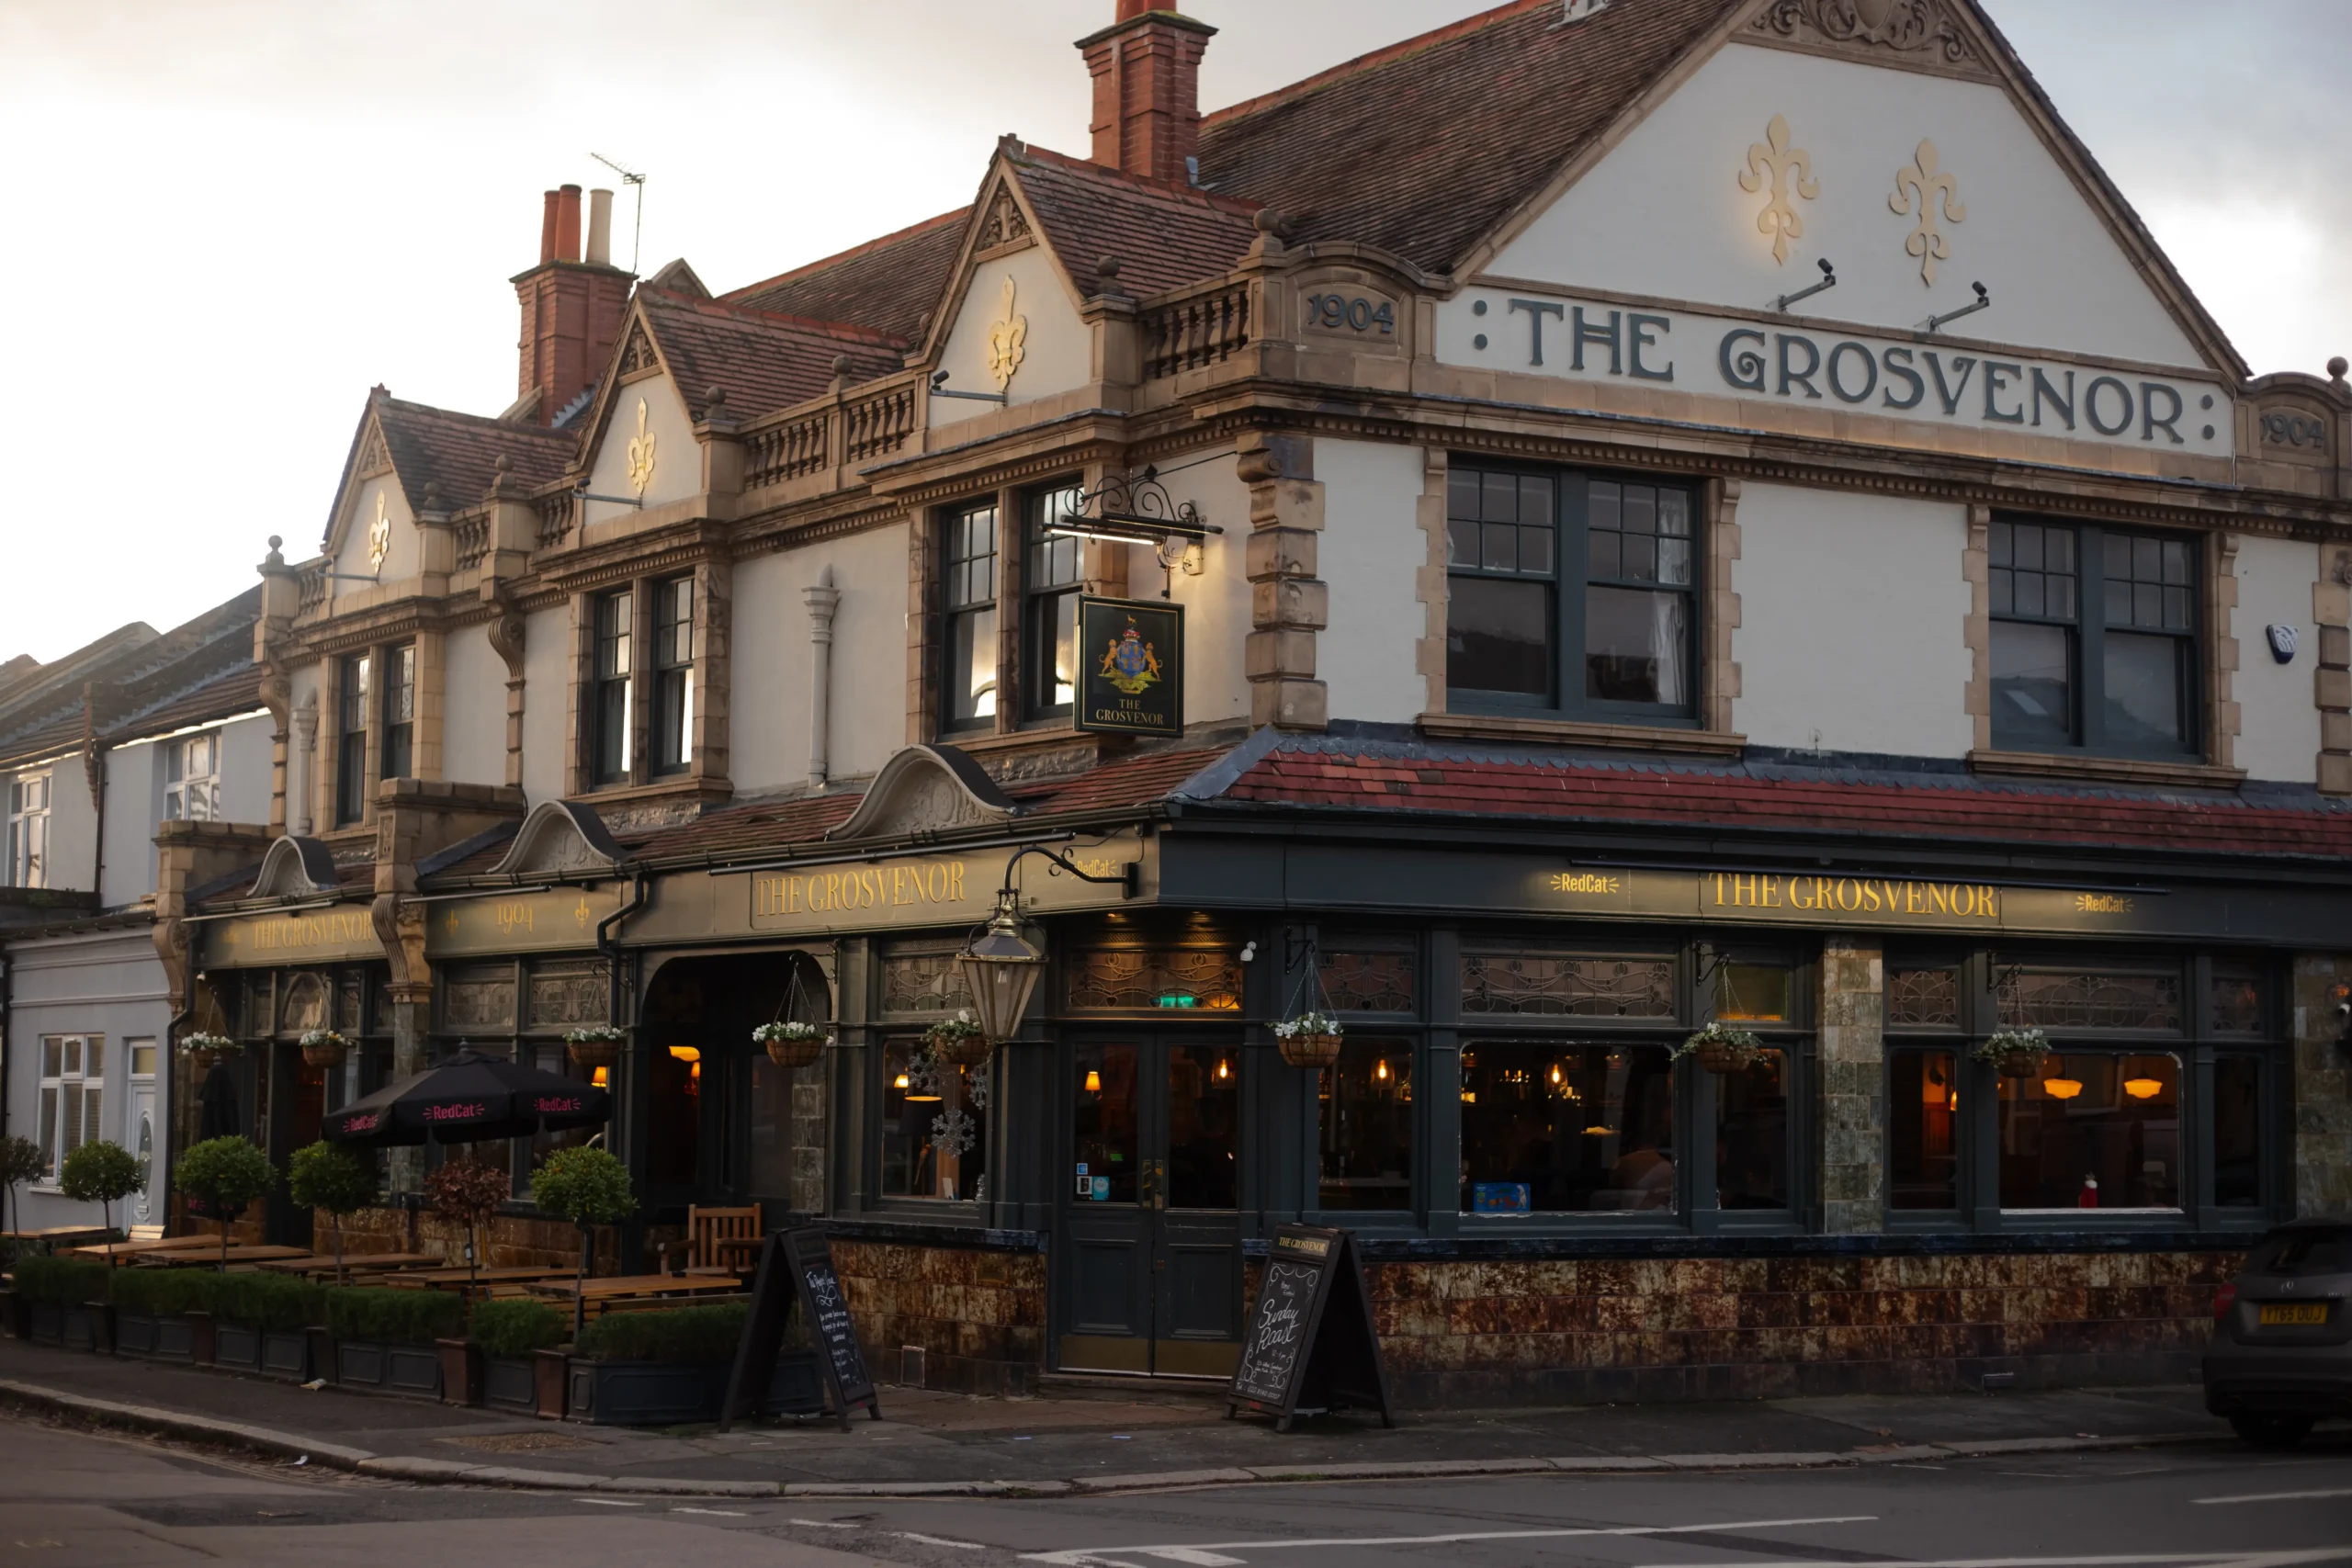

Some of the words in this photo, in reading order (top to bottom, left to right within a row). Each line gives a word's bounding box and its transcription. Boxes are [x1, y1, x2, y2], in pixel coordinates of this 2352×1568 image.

[1308, 294, 1394, 333] 1904
[1509, 297, 1675, 382] THE
[1717, 327, 2185, 445] GROSVENOR
[1119, 698, 1140, 710] THE
[1095, 709, 1163, 725] GROSVENOR
[757, 875, 803, 916] THE
[807, 862, 966, 911] GROSVENOR
[1562, 873, 1608, 893] RedCat
[1708, 873, 1781, 908] THE
[1789, 875, 1996, 917] GROSVENOR
[2086, 894, 2124, 912] RedCat
[254, 920, 278, 950] THE
[281, 911, 371, 948] GROSVENOR
[496, 903, 534, 934] 1904
[434, 1103, 474, 1120] RedCat
[539, 1098, 571, 1112] RedCat
[350, 1115, 376, 1132] RedCat
[1279, 1236, 1291, 1247] THE
[1291, 1238, 1326, 1253] GROSVENOR
[1258, 1299, 1300, 1329] Sunday
[1256, 1326, 1296, 1354] Roast
